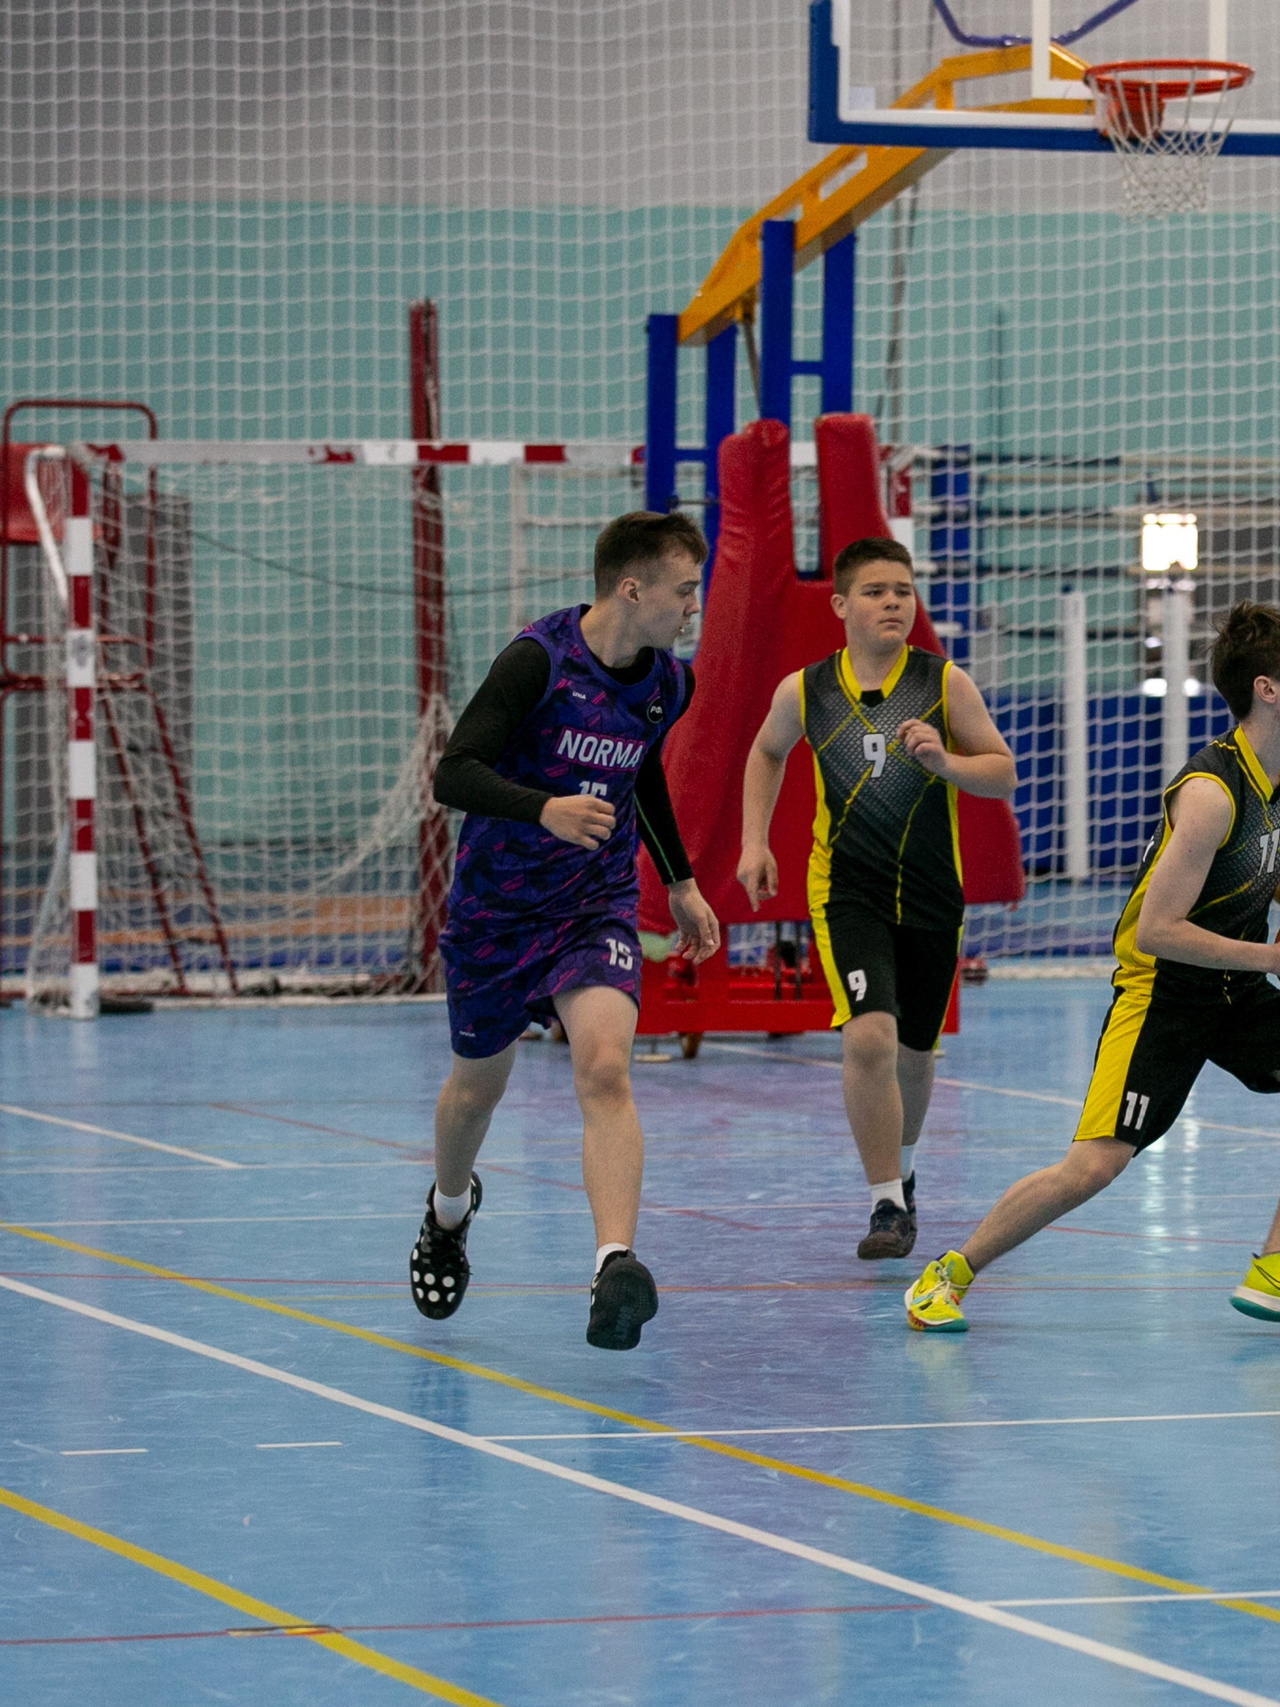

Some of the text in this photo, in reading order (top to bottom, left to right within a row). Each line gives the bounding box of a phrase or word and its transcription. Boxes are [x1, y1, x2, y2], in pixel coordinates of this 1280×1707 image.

[557, 730, 644, 768] NORMA
[863, 733, 886, 778] 9
[1257, 828, 1280, 876] 11
[606, 938, 633, 971] 15
[847, 969, 867, 1002] 9
[1122, 1091, 1151, 1131] 11
